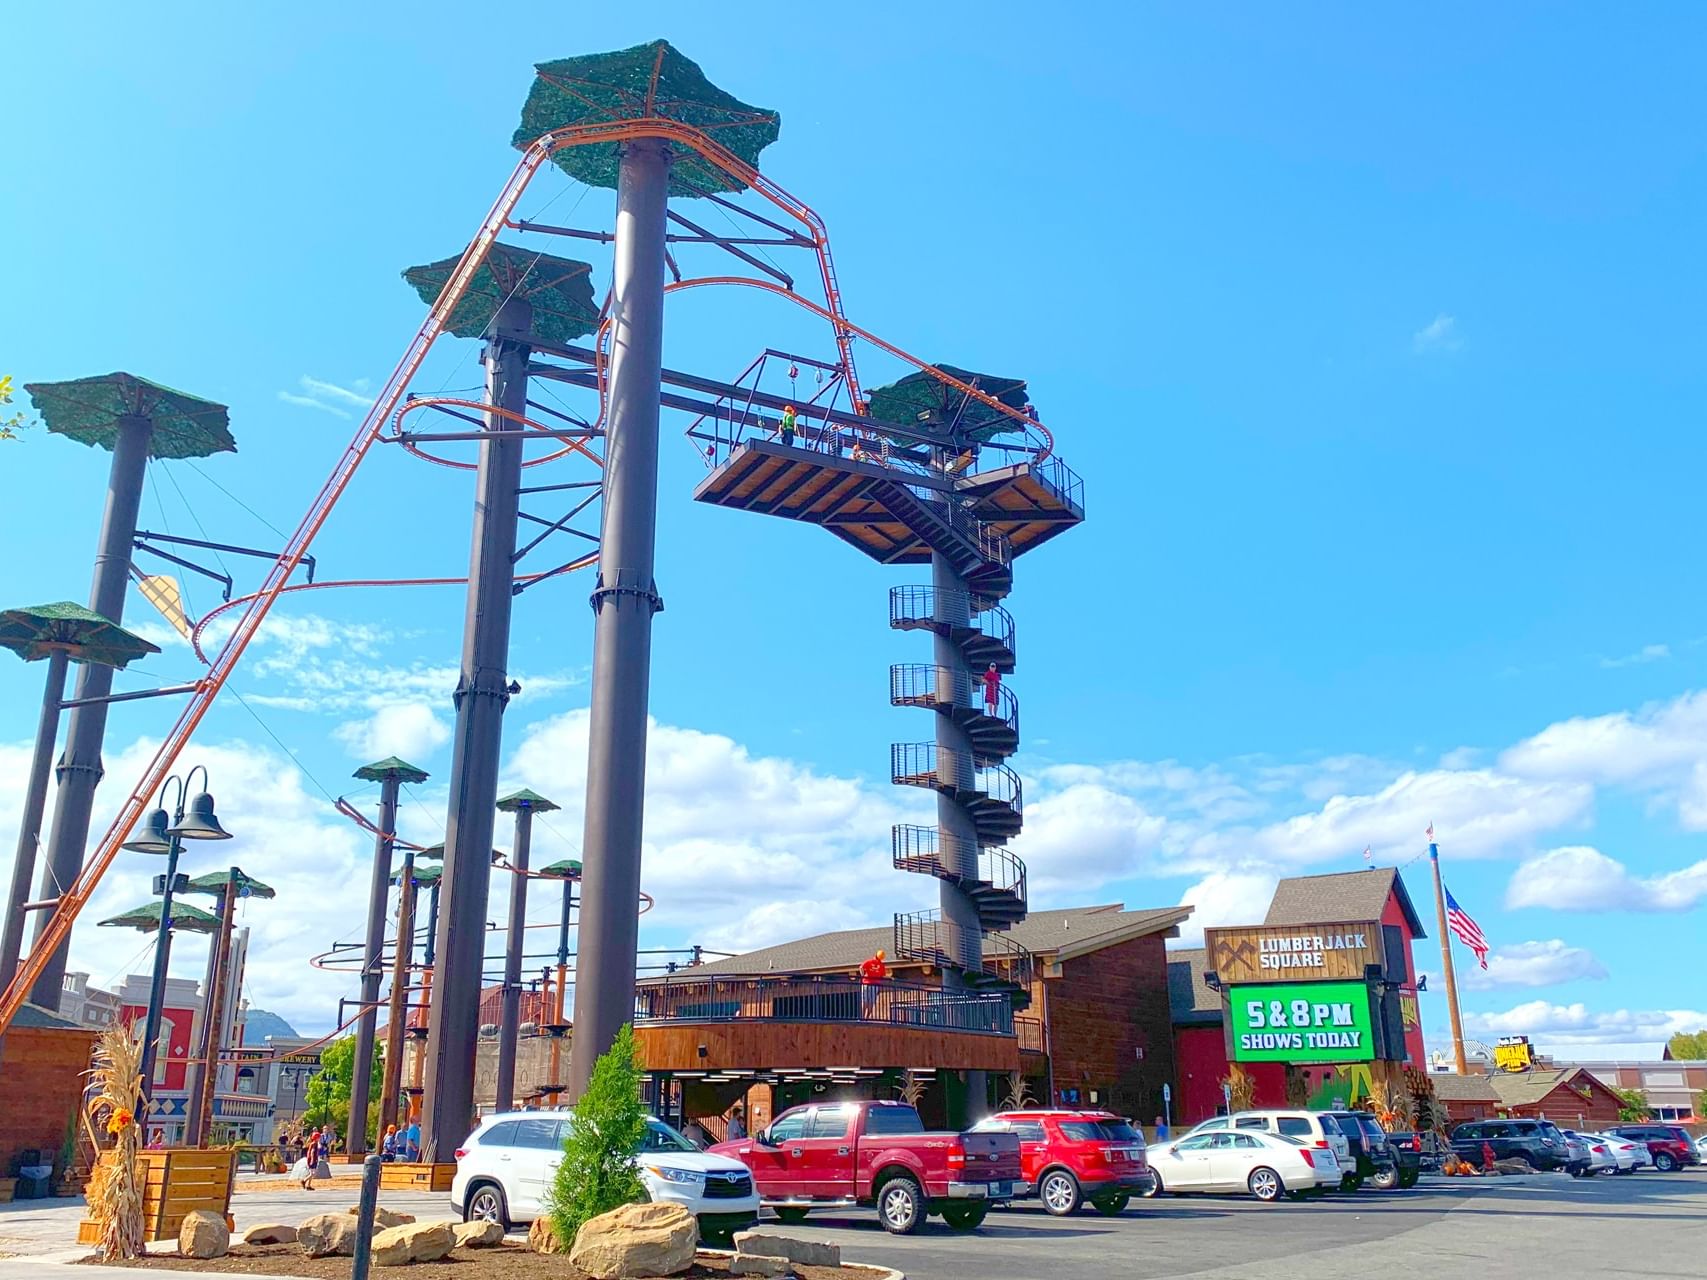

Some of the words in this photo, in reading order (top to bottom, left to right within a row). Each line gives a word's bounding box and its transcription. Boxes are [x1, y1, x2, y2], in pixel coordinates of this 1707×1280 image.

[1260, 934, 1367, 953] LUMBERJACK
[1260, 952, 1323, 969] SQUARE
[1241, 1033, 1302, 1049] SHOWS
[1306, 1032, 1360, 1048] TODAY
